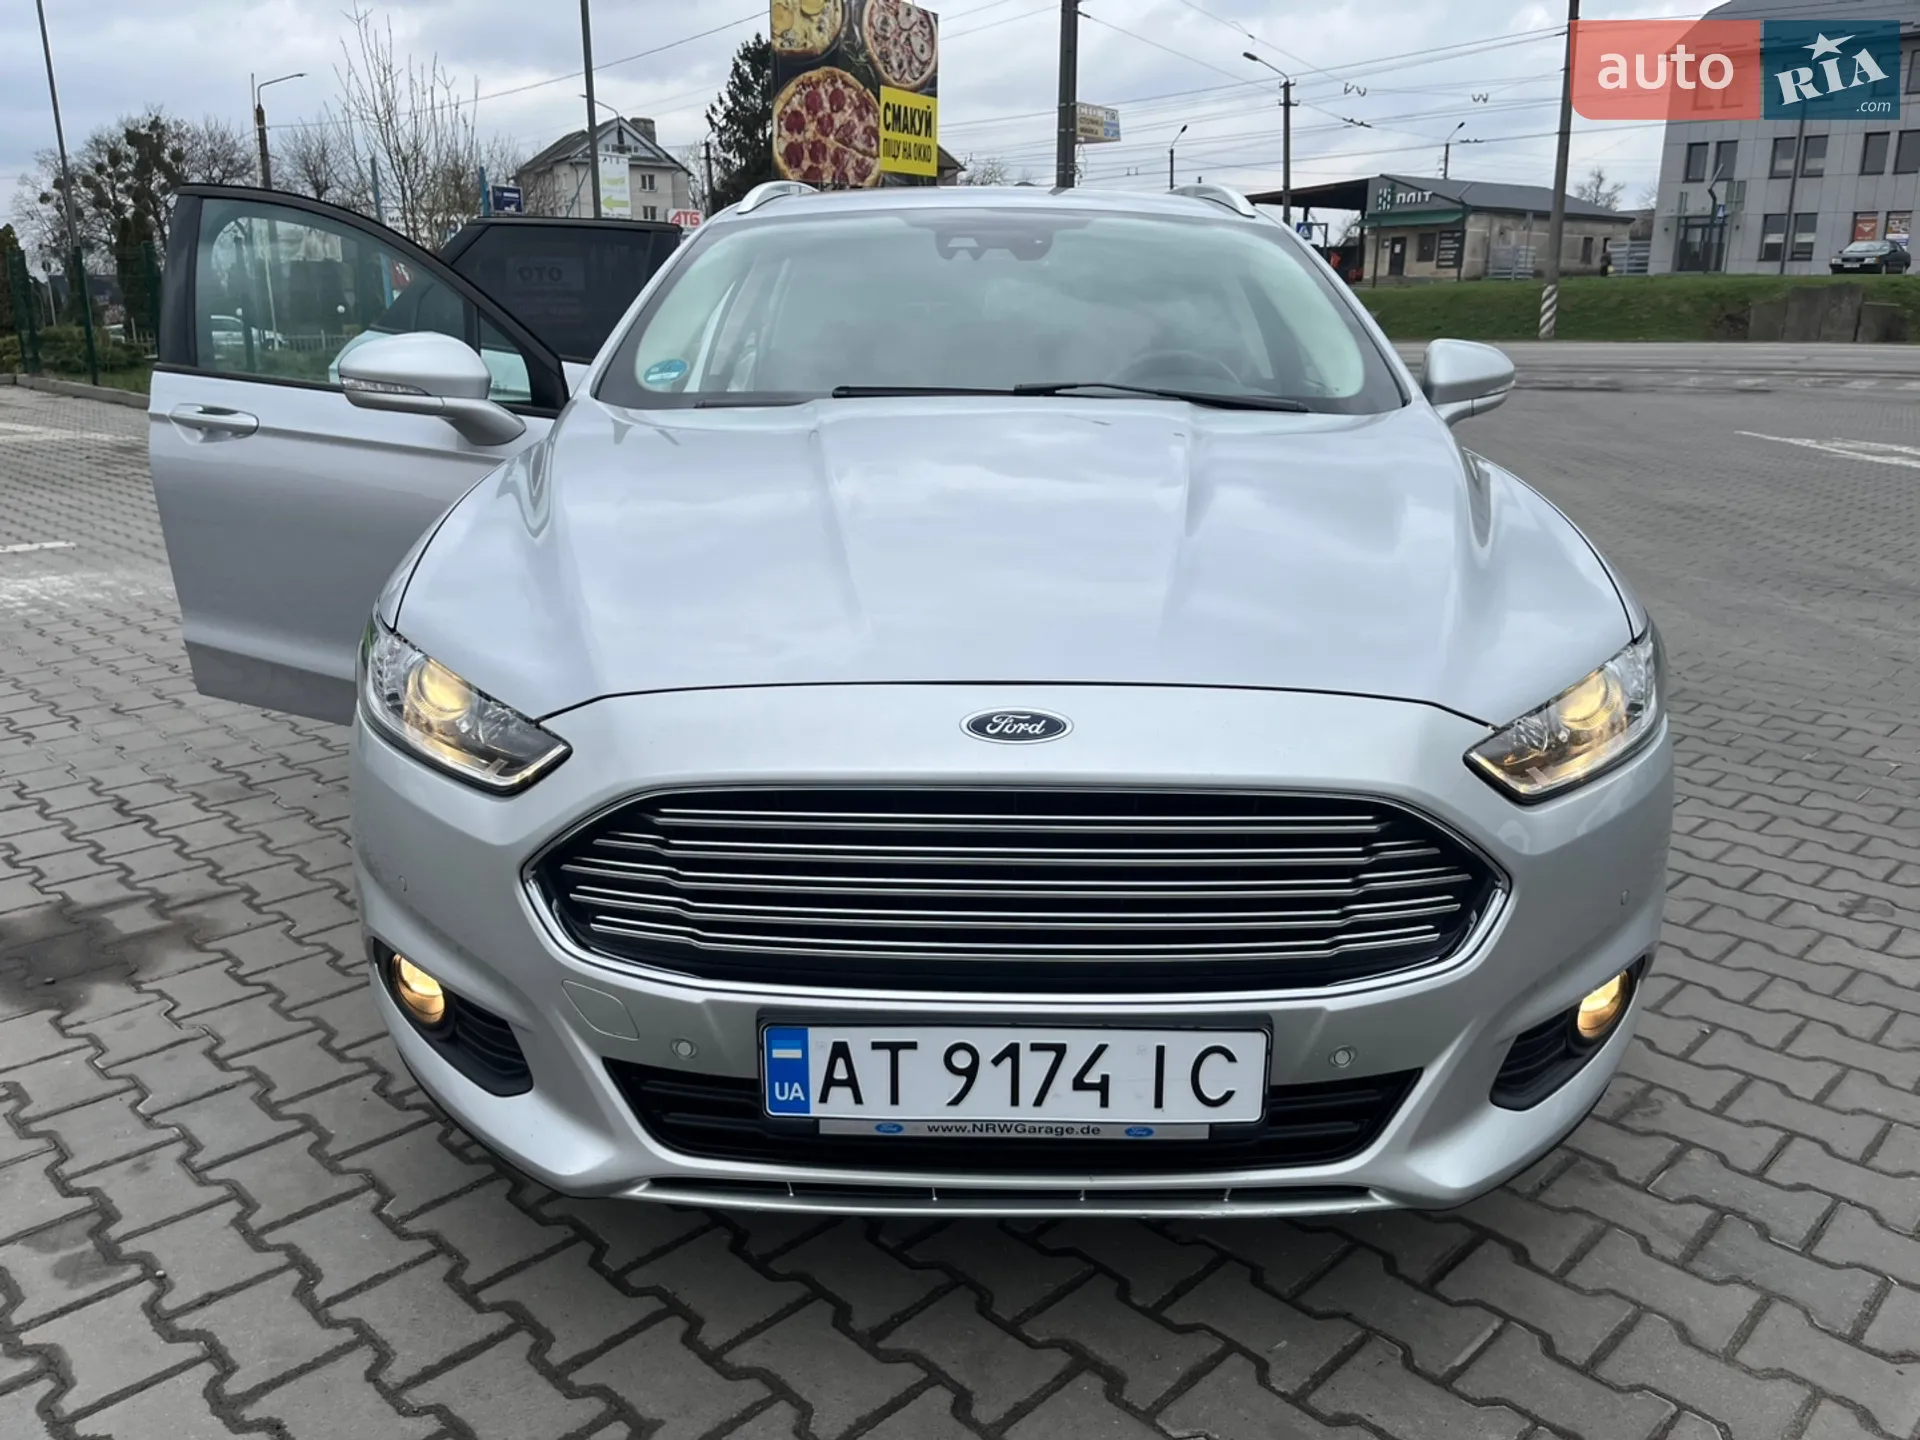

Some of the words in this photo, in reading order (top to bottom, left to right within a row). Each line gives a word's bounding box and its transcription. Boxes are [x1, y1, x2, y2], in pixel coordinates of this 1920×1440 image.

[883, 102, 932, 138] СМАКУЙ
[883, 138, 900, 161] ПІЦУ
[902, 141, 912, 160] НА
[914, 143, 932, 163] ОККО
[1396, 191, 1432, 205] ПЛІТ
[986, 715, 1046, 734] Ford
[818, 1041, 918, 1106] AT
[943, 1042, 1110, 1108] 9174
[1154, 1045, 1238, 1109] IC
[775, 1082, 805, 1101] UA
[926, 1123, 1101, 1137] www.NRWGarage.de
